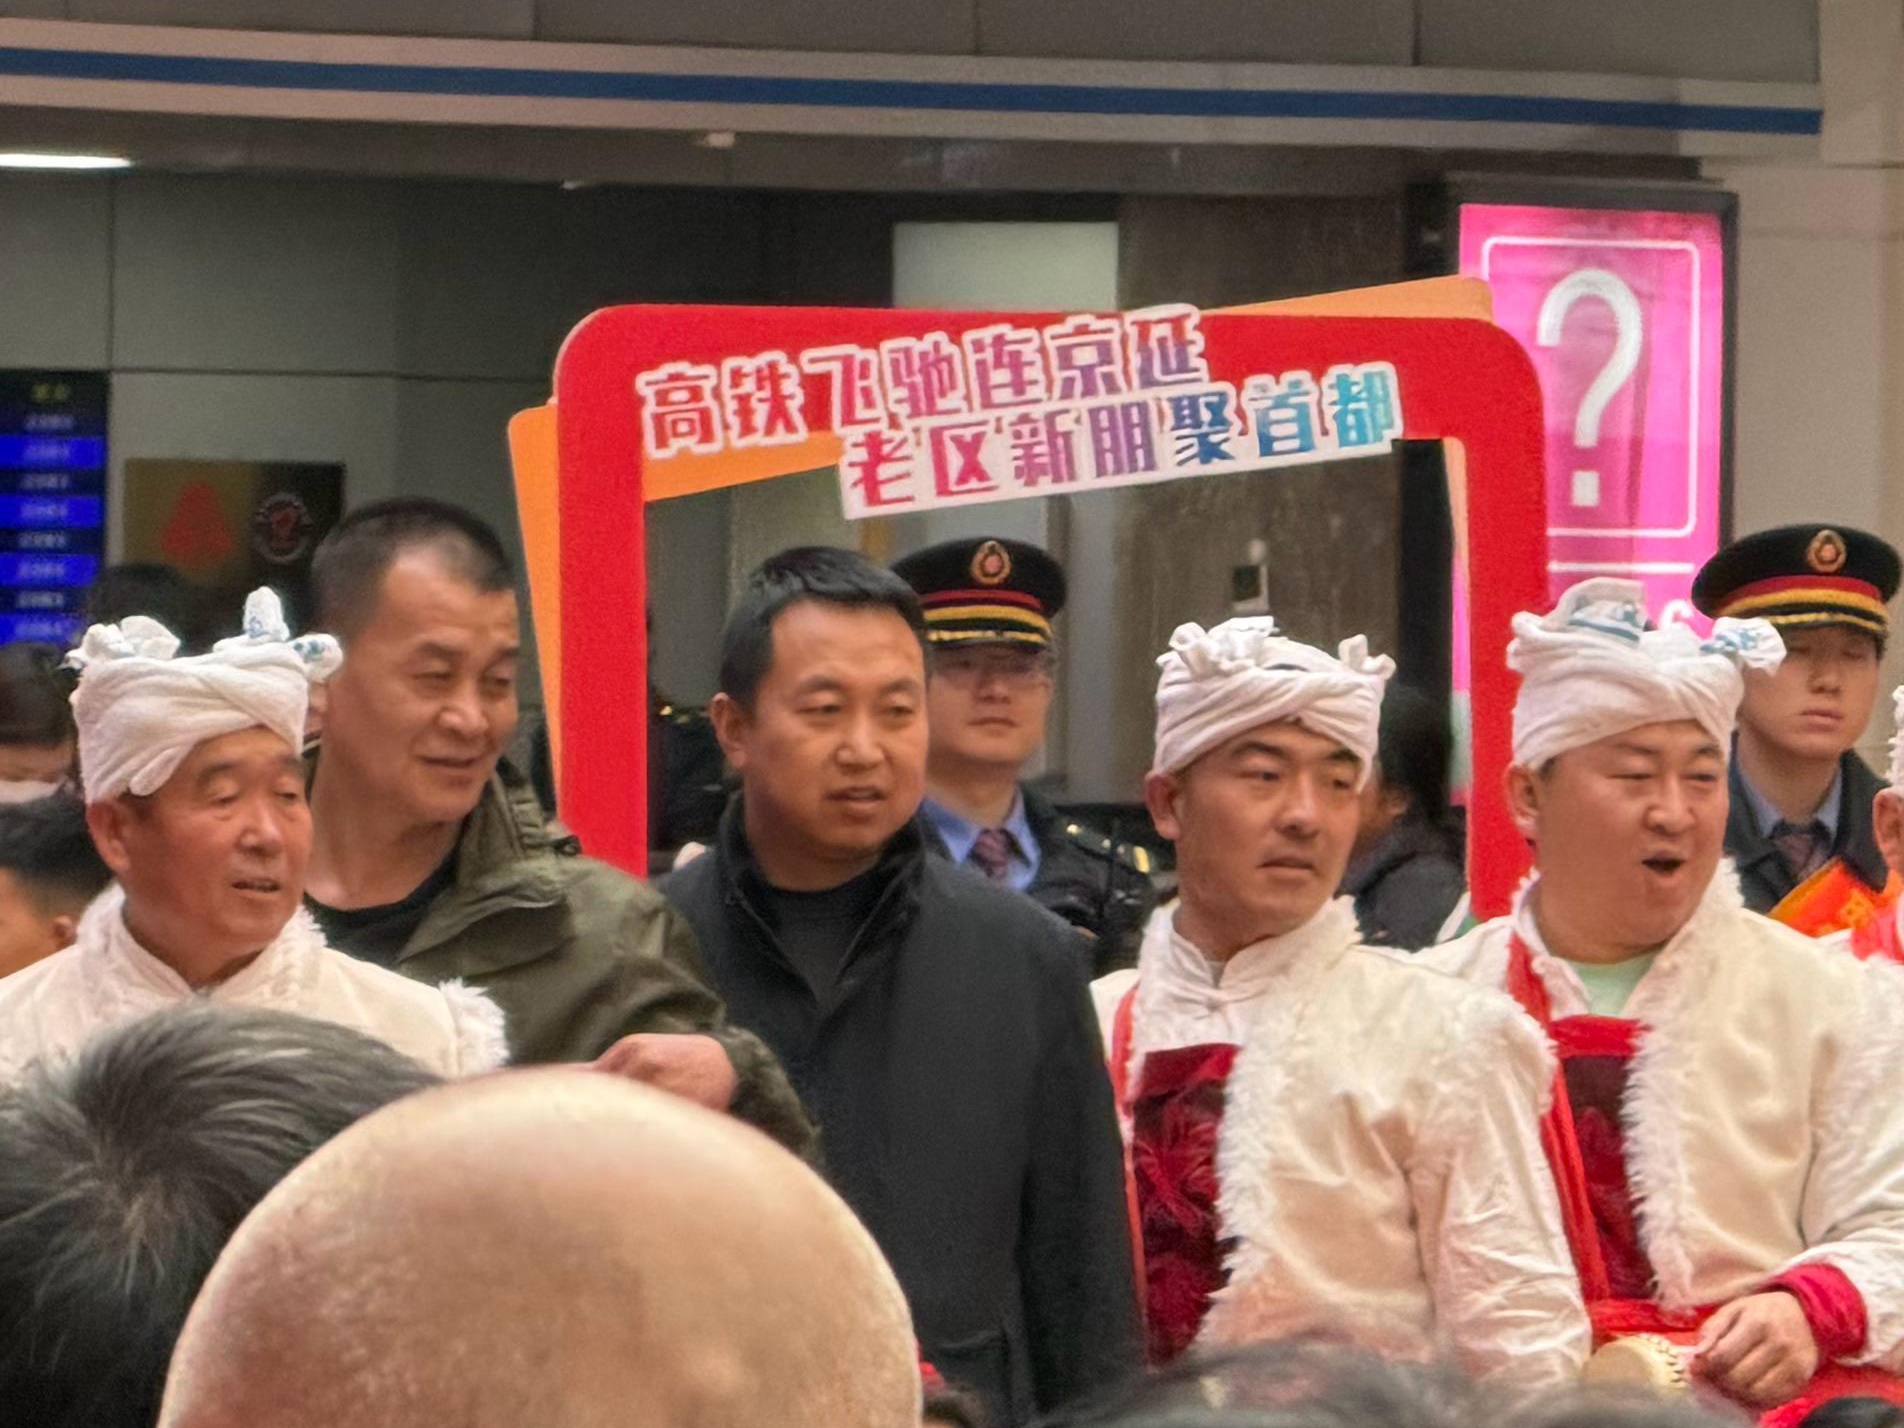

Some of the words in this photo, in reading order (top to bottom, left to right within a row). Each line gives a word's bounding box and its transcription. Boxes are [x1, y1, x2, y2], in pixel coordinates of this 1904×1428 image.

[639, 309, 1204, 454] 高铁飞驰连京延
[848, 368, 1397, 509] 老区新朋聚首都
